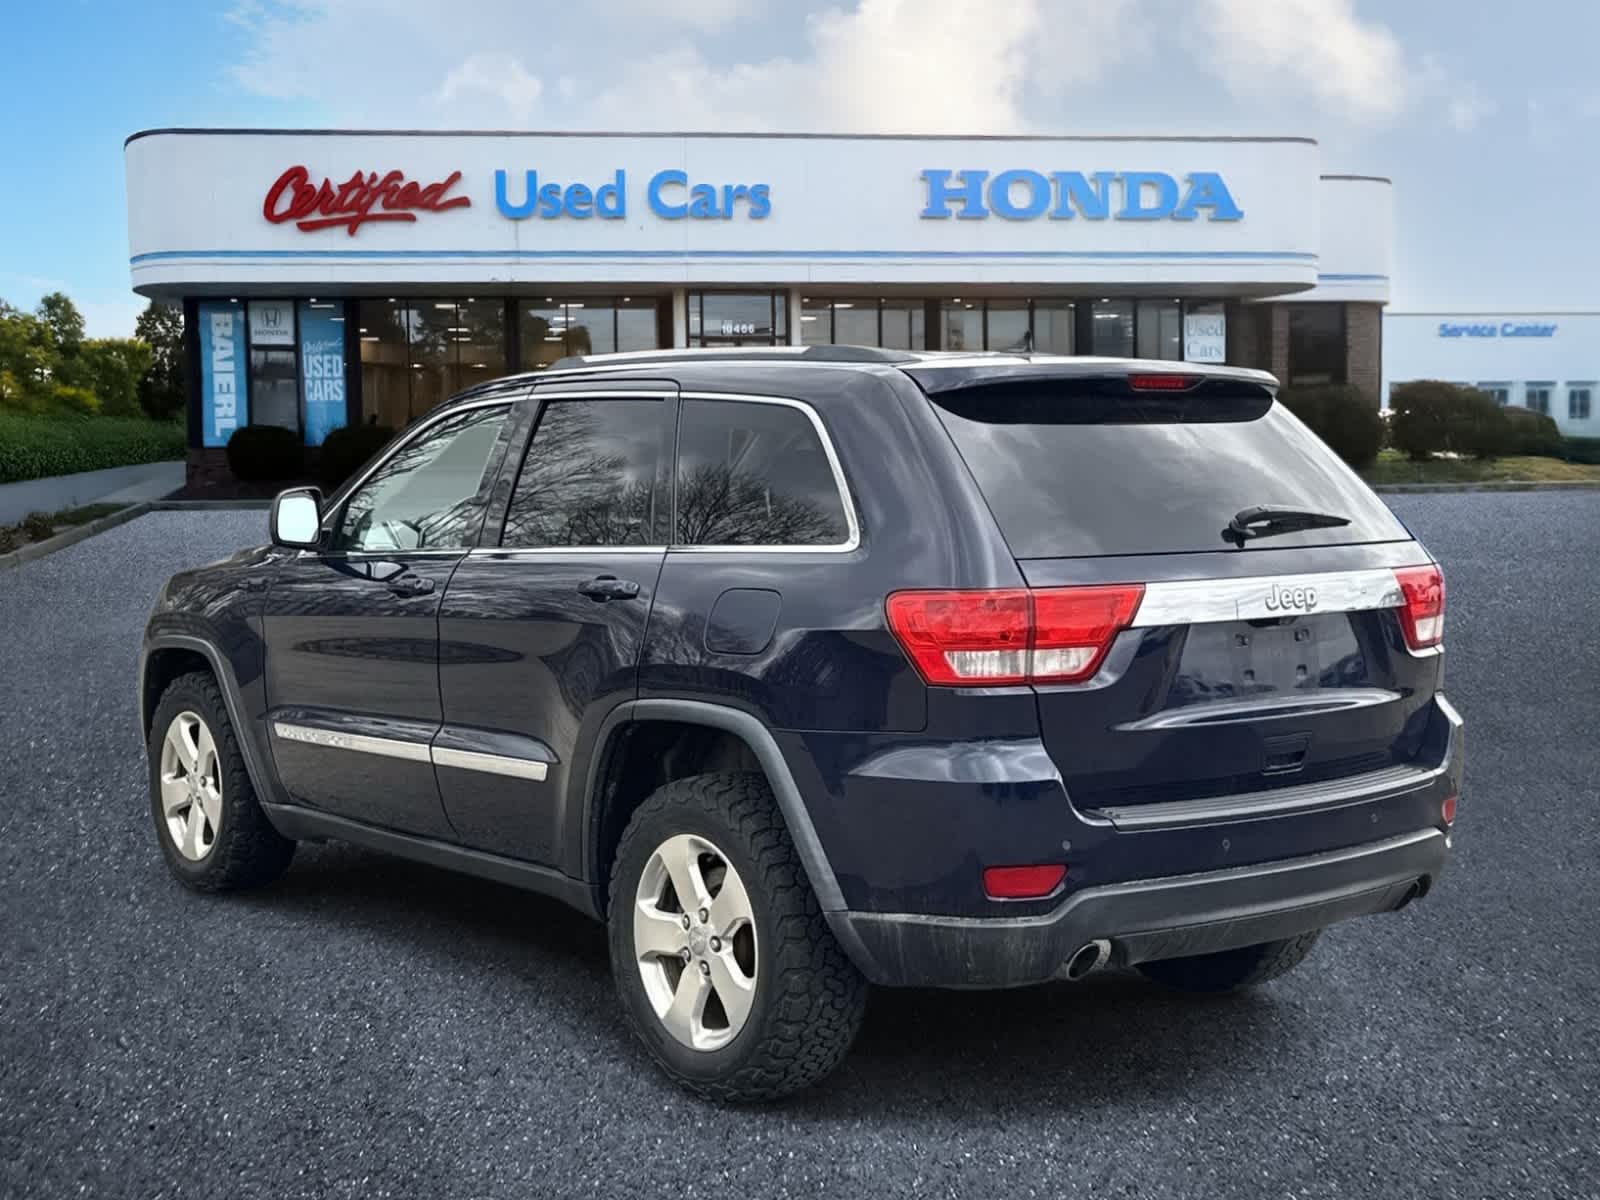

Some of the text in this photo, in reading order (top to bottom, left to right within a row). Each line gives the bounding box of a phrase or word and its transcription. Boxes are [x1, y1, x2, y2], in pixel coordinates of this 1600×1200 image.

[263, 165, 772, 236] Certified Used Cars
[920, 169, 1245, 221] HONDA
[1186, 319, 1224, 337] Used
[1438, 322, 1558, 338] Service Center
[1187, 340, 1224, 359] Cars
[210, 313, 238, 437] BAIERL
[303, 354, 344, 377] USED
[304, 379, 344, 403] CARS
[1265, 584, 1318, 612] Jeep
